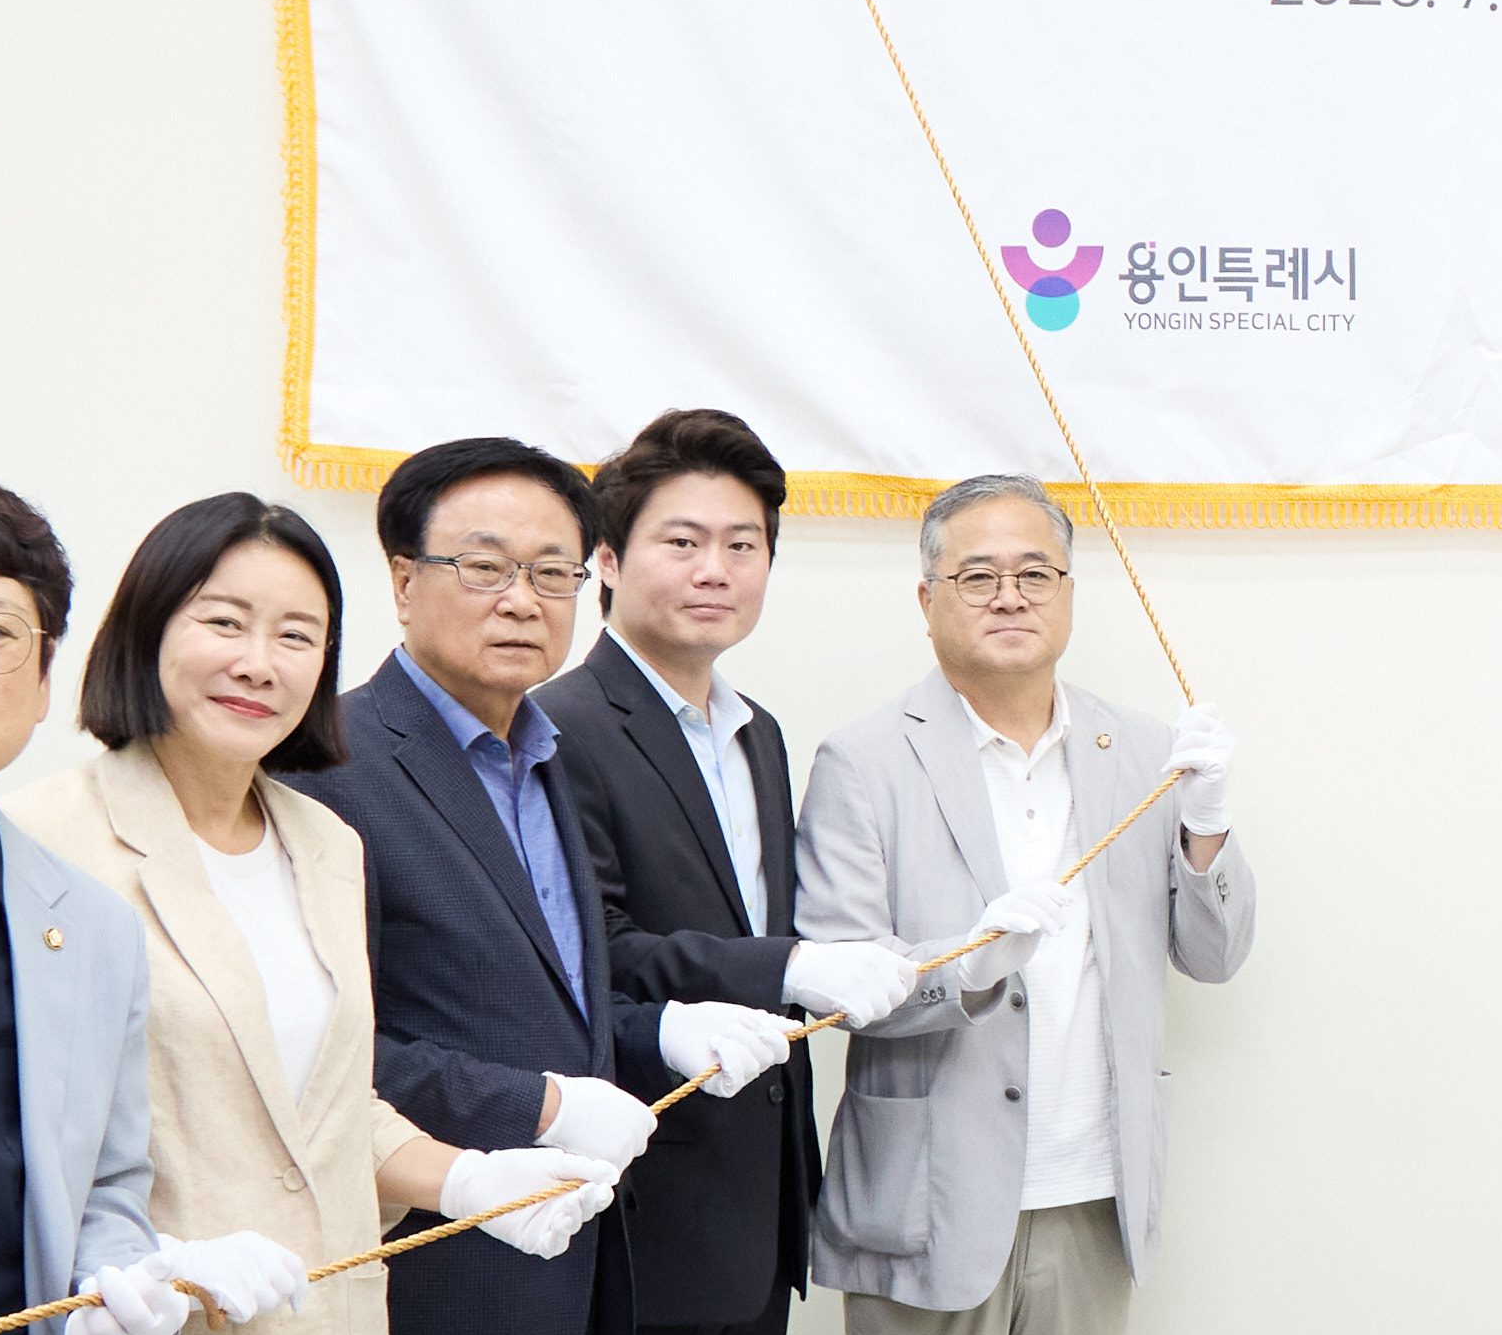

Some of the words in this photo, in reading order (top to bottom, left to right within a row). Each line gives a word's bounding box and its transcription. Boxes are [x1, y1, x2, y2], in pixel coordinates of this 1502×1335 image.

[1118, 241, 1356, 305] 용인특례시
[1123, 312, 1203, 330] YONGIN
[1209, 312, 1301, 331] SPECIAL
[1306, 313, 1356, 332] CITY
